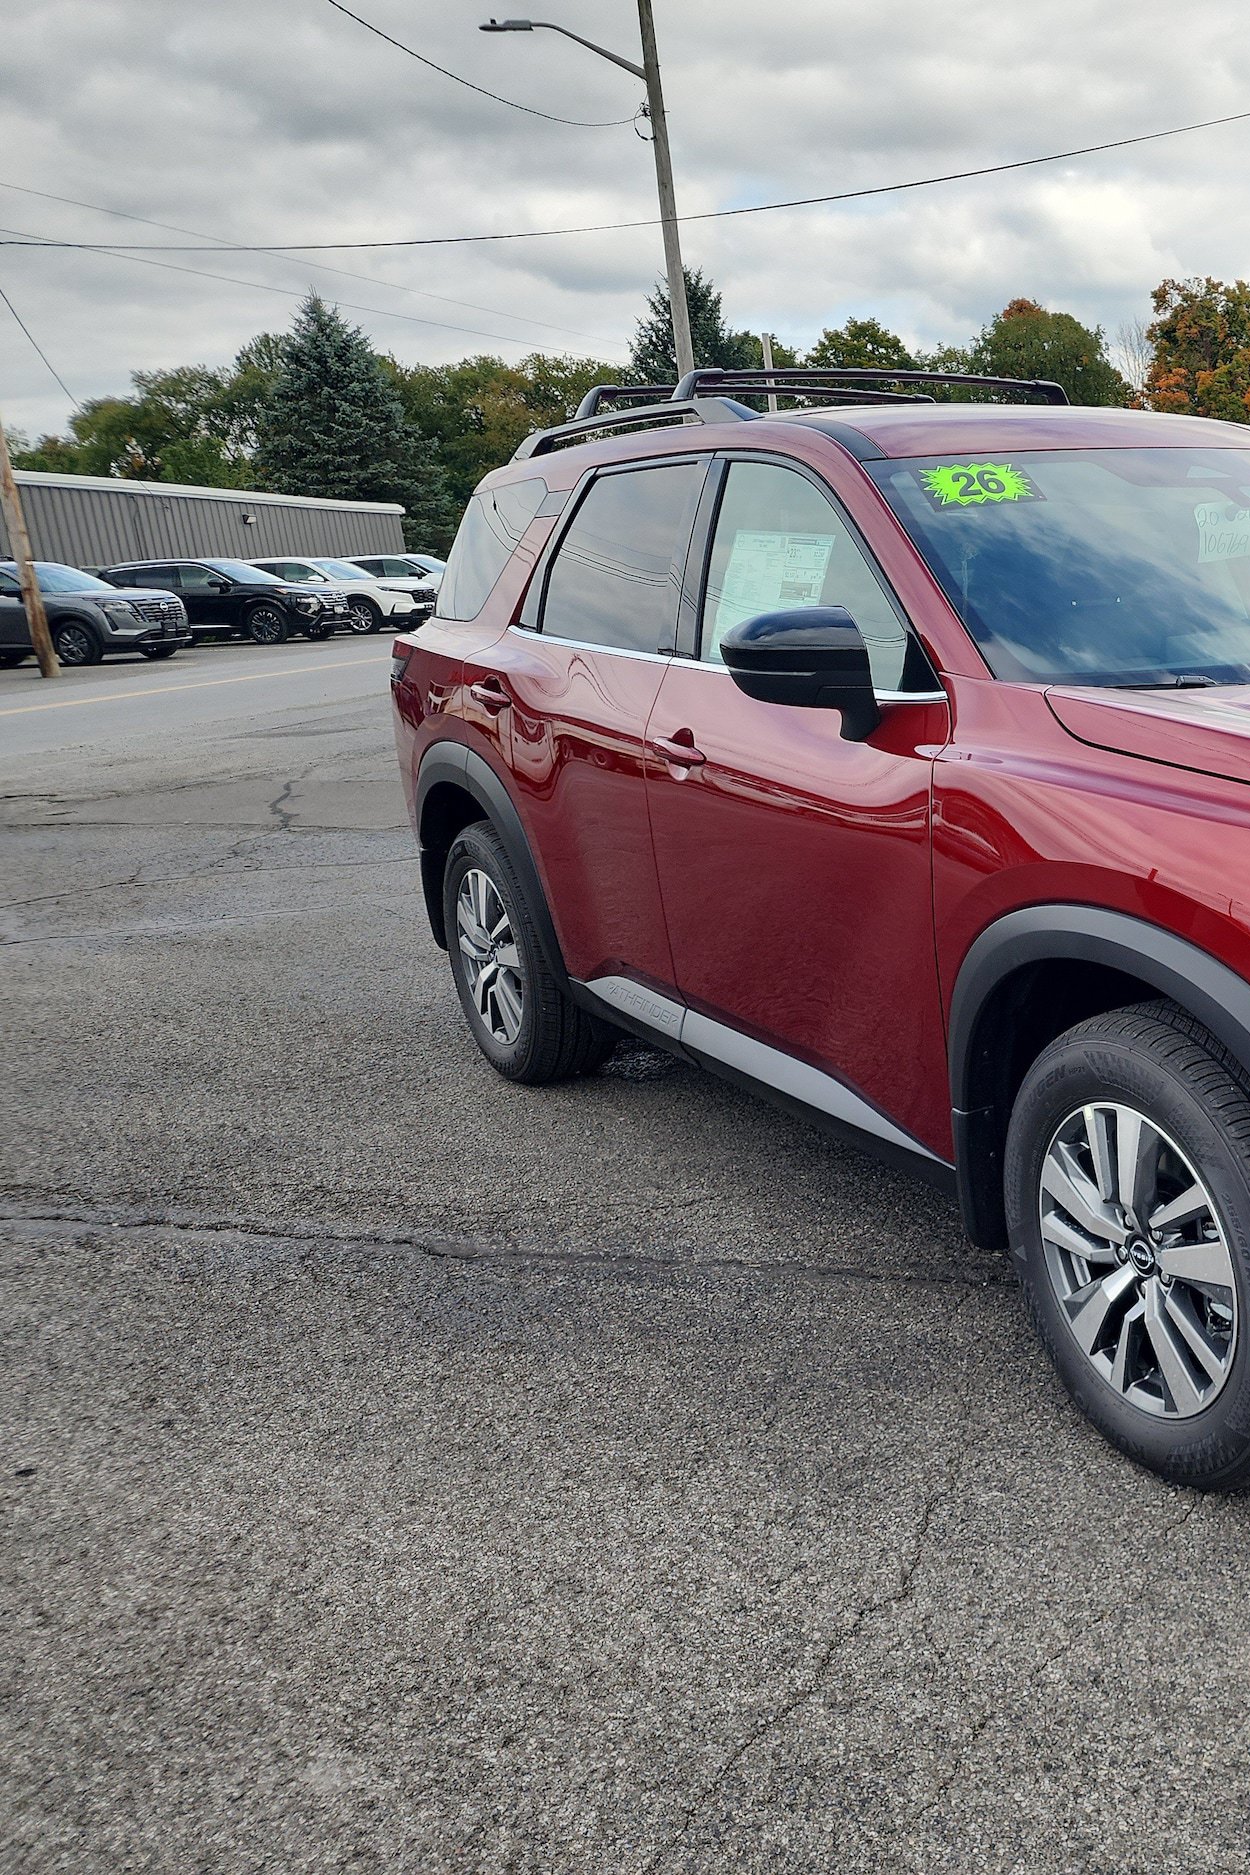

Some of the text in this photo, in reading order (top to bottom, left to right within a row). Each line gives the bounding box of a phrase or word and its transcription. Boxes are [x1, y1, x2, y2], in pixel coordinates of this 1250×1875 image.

[952, 470, 1006, 497] 26
[1198, 507, 1219, 528] 20
[1204, 531, 1250, 556] 106769
[607, 981, 680, 1025] PATHFINDER
